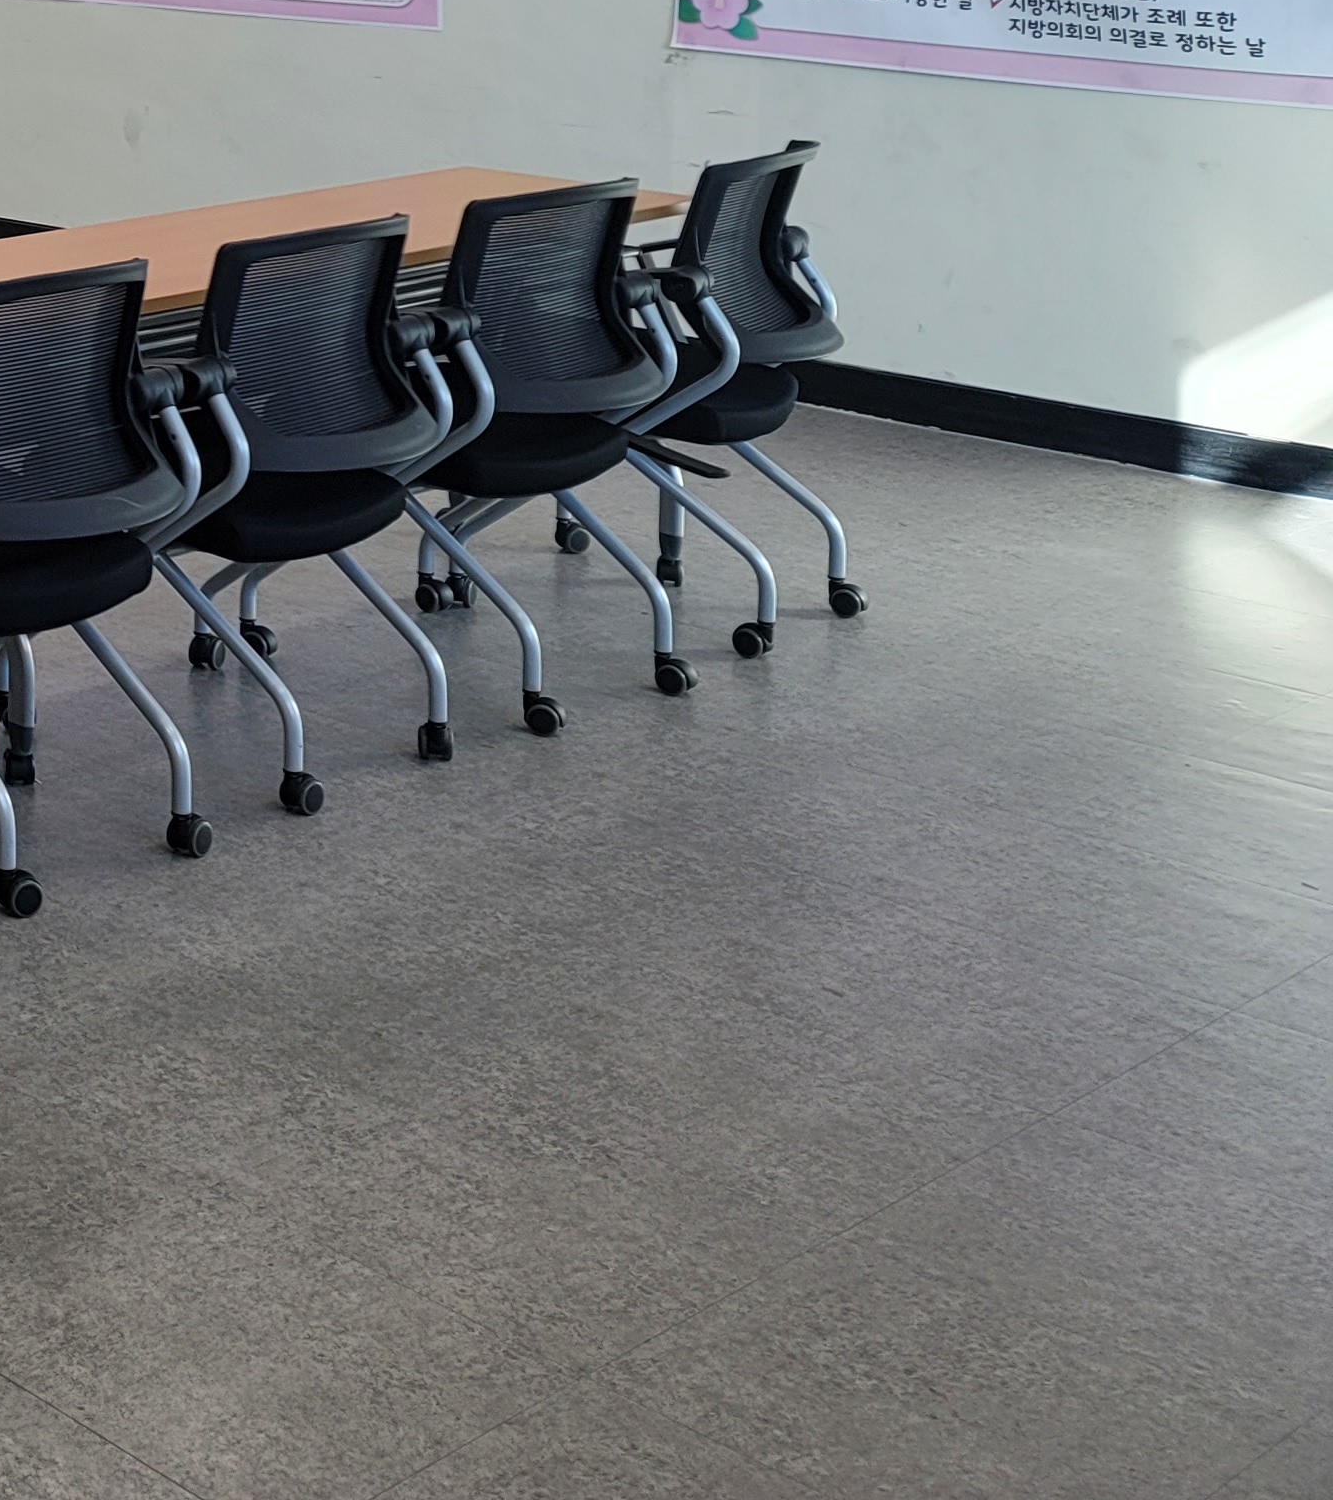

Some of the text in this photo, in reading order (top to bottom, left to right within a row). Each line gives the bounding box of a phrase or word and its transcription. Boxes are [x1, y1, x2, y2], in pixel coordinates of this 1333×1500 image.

[1146, 8, 1186, 28] 조례
[1194, 10, 1238, 33] 또한
[1008, 18, 1266, 58] 지방의회의 의결로 정하는 날
